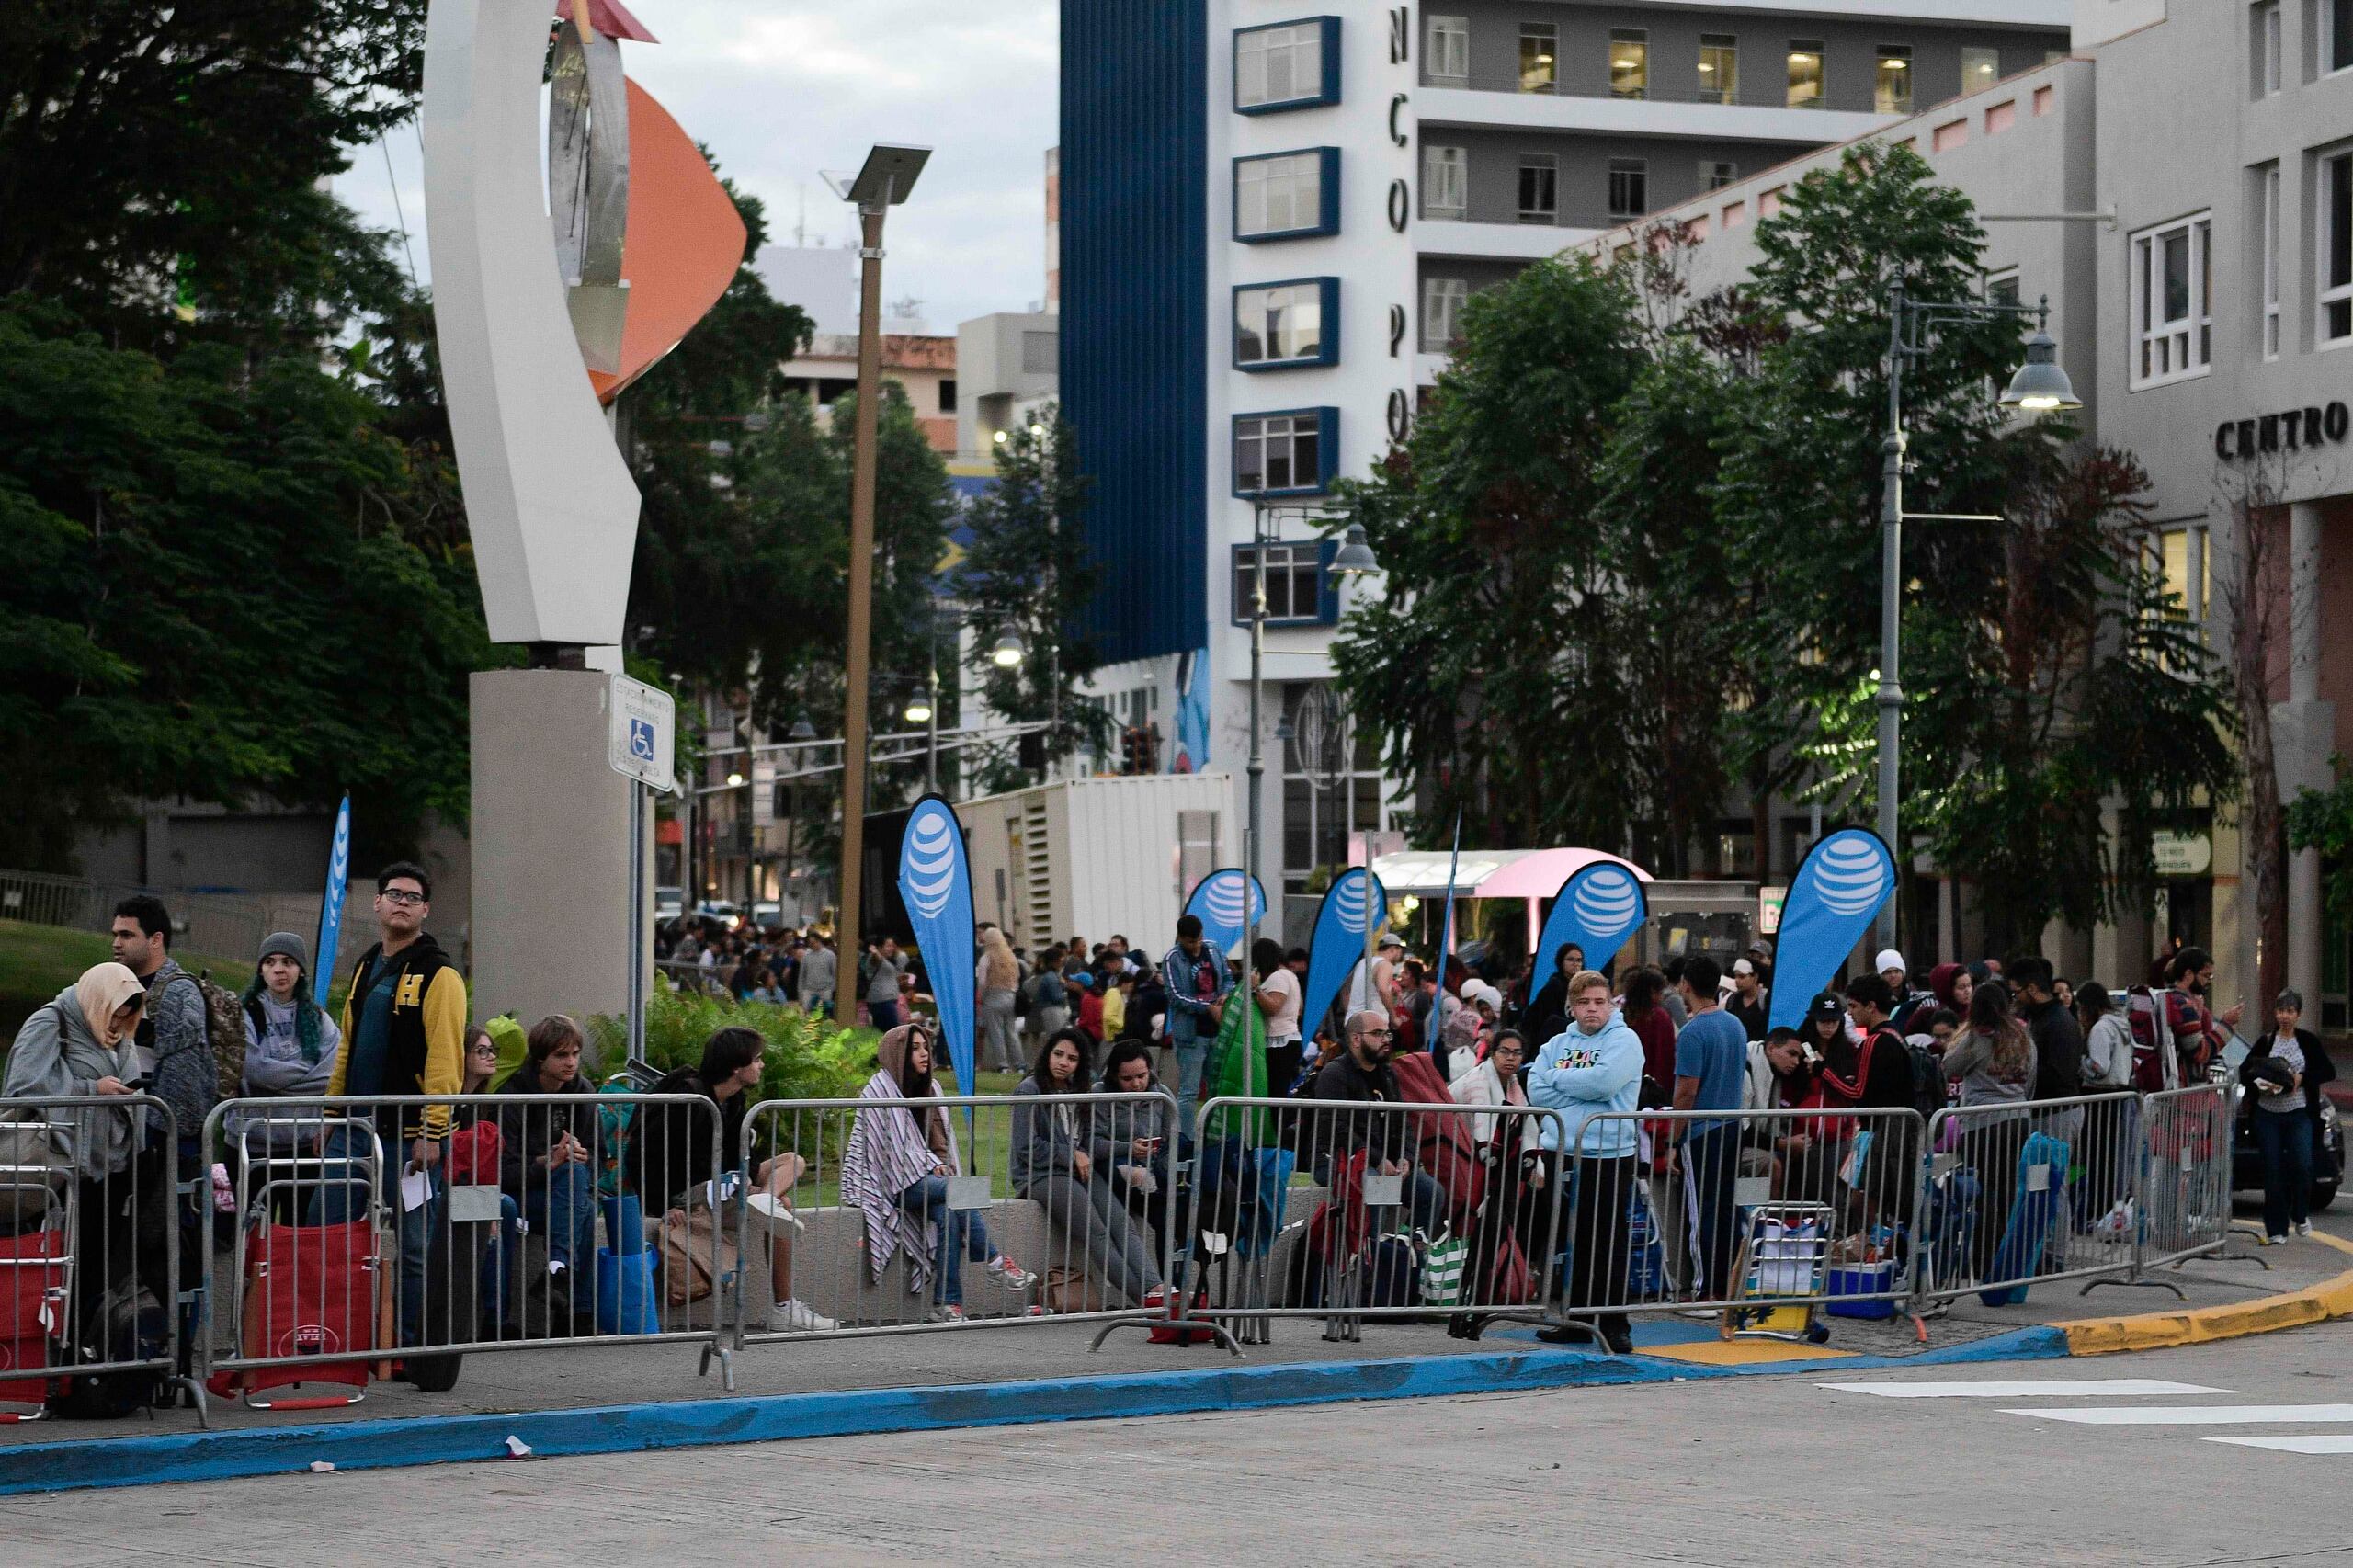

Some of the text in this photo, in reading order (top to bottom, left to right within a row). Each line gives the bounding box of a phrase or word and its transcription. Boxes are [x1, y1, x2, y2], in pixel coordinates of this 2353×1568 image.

[2215, 400, 2349, 461] CENTRO
[397, 973, 425, 1006] H
[1563, 1048, 1602, 1063] VLOG
